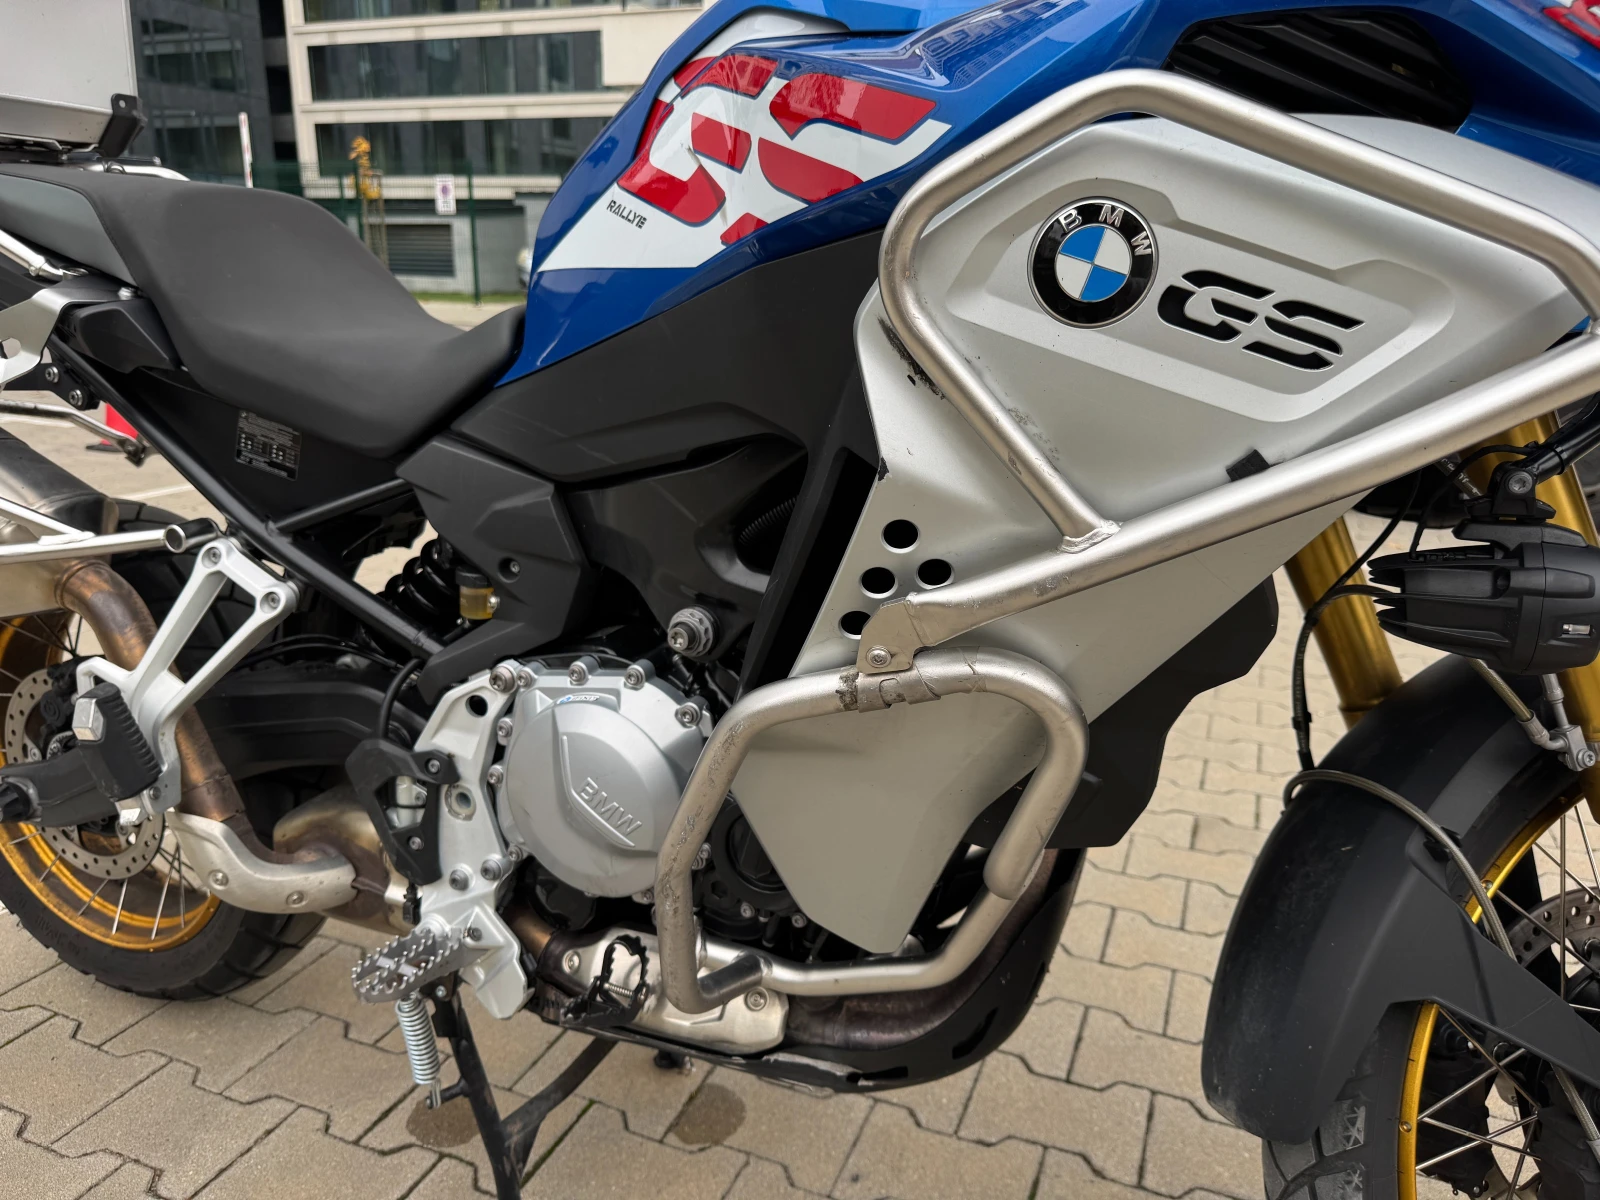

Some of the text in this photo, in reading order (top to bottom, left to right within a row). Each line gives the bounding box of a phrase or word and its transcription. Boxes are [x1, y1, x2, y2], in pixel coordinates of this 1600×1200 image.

[606, 199, 648, 230] RALLYE
[1058, 204, 1152, 256] BMW
[1157, 269, 1366, 373] GS
[579, 776, 643, 837] BMW
